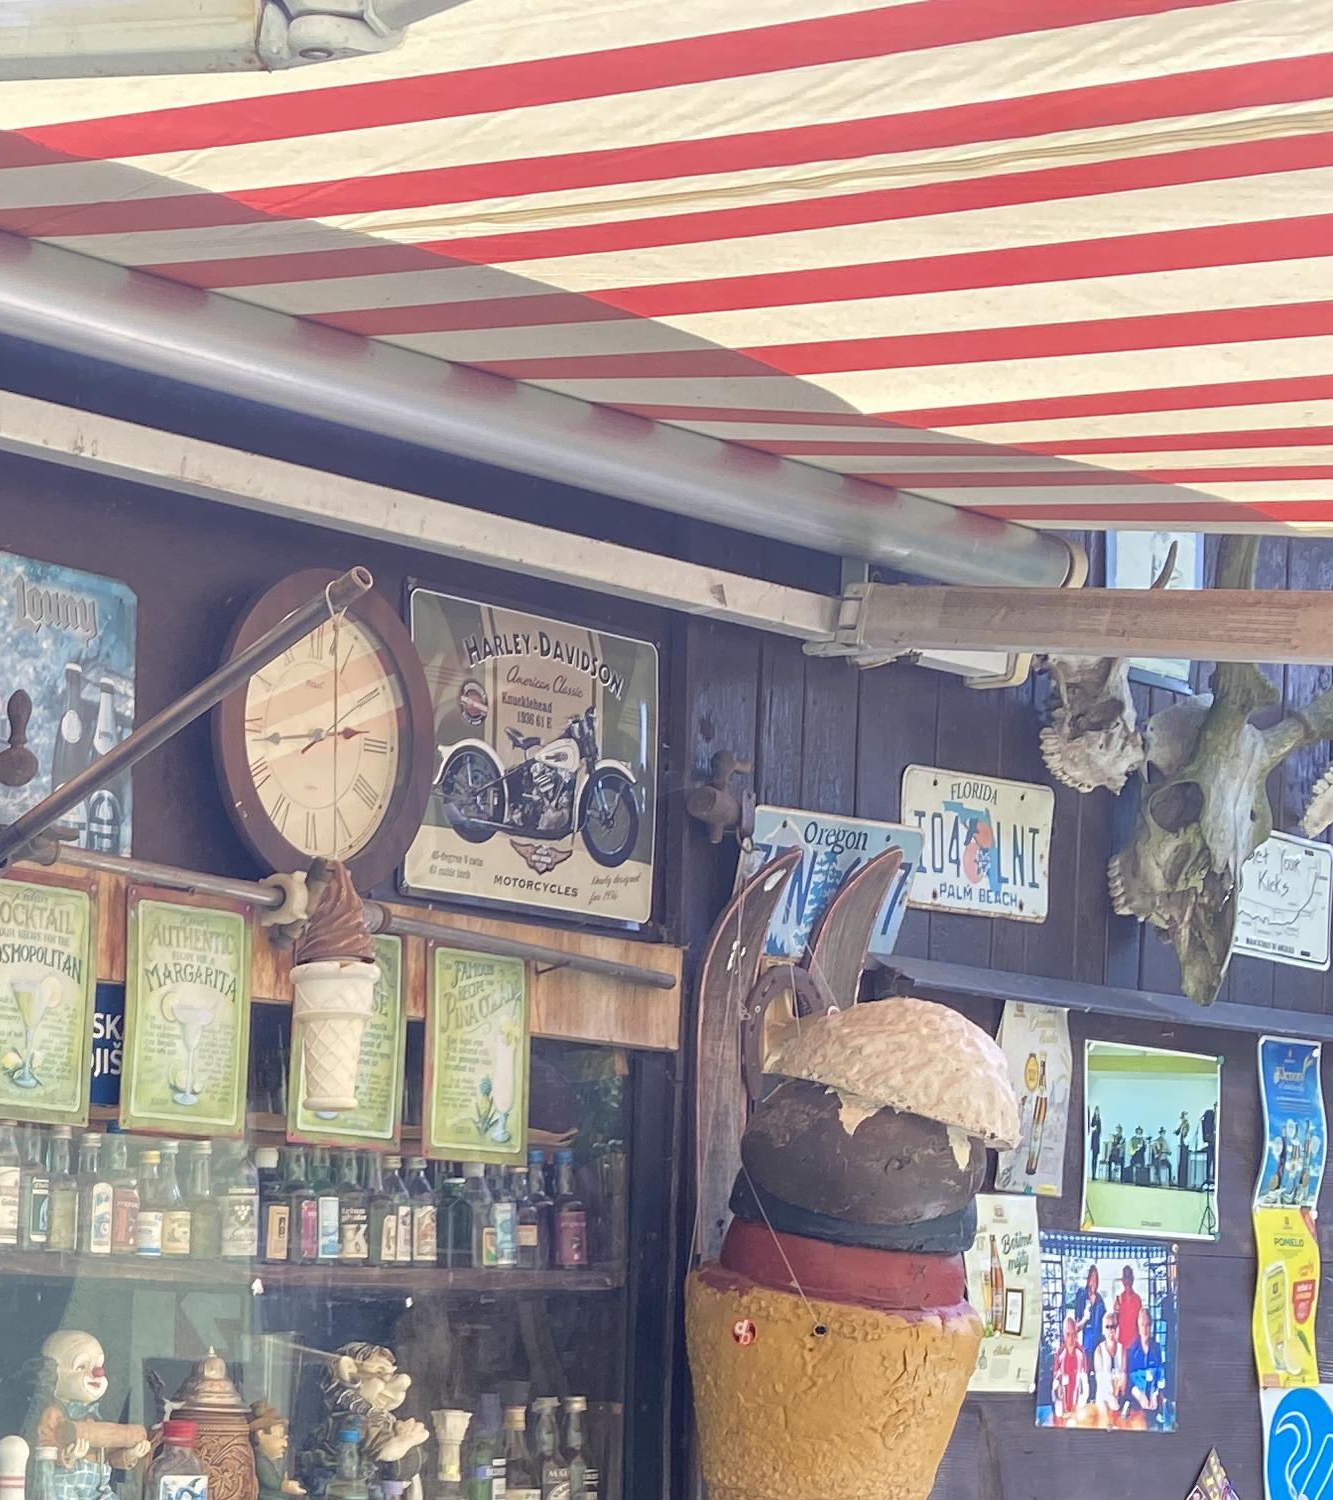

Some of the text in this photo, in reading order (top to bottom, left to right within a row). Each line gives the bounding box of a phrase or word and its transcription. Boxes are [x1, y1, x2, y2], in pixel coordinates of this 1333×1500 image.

[507, 665, 583, 699] American Classic
[501, 691, 552, 714] Knucklehead
[950, 782, 1000, 806] FLORIDA
[804, 821, 867, 855] Oregon
[494, 874, 579, 898] MOTORCYCLES
[939, 882, 1019, 908] PALM BEACH
[1257, 871, 1290, 898] Kicks
[149, 918, 236, 956] AUTHENTIC
[144, 961, 237, 1005] MARGARITA
